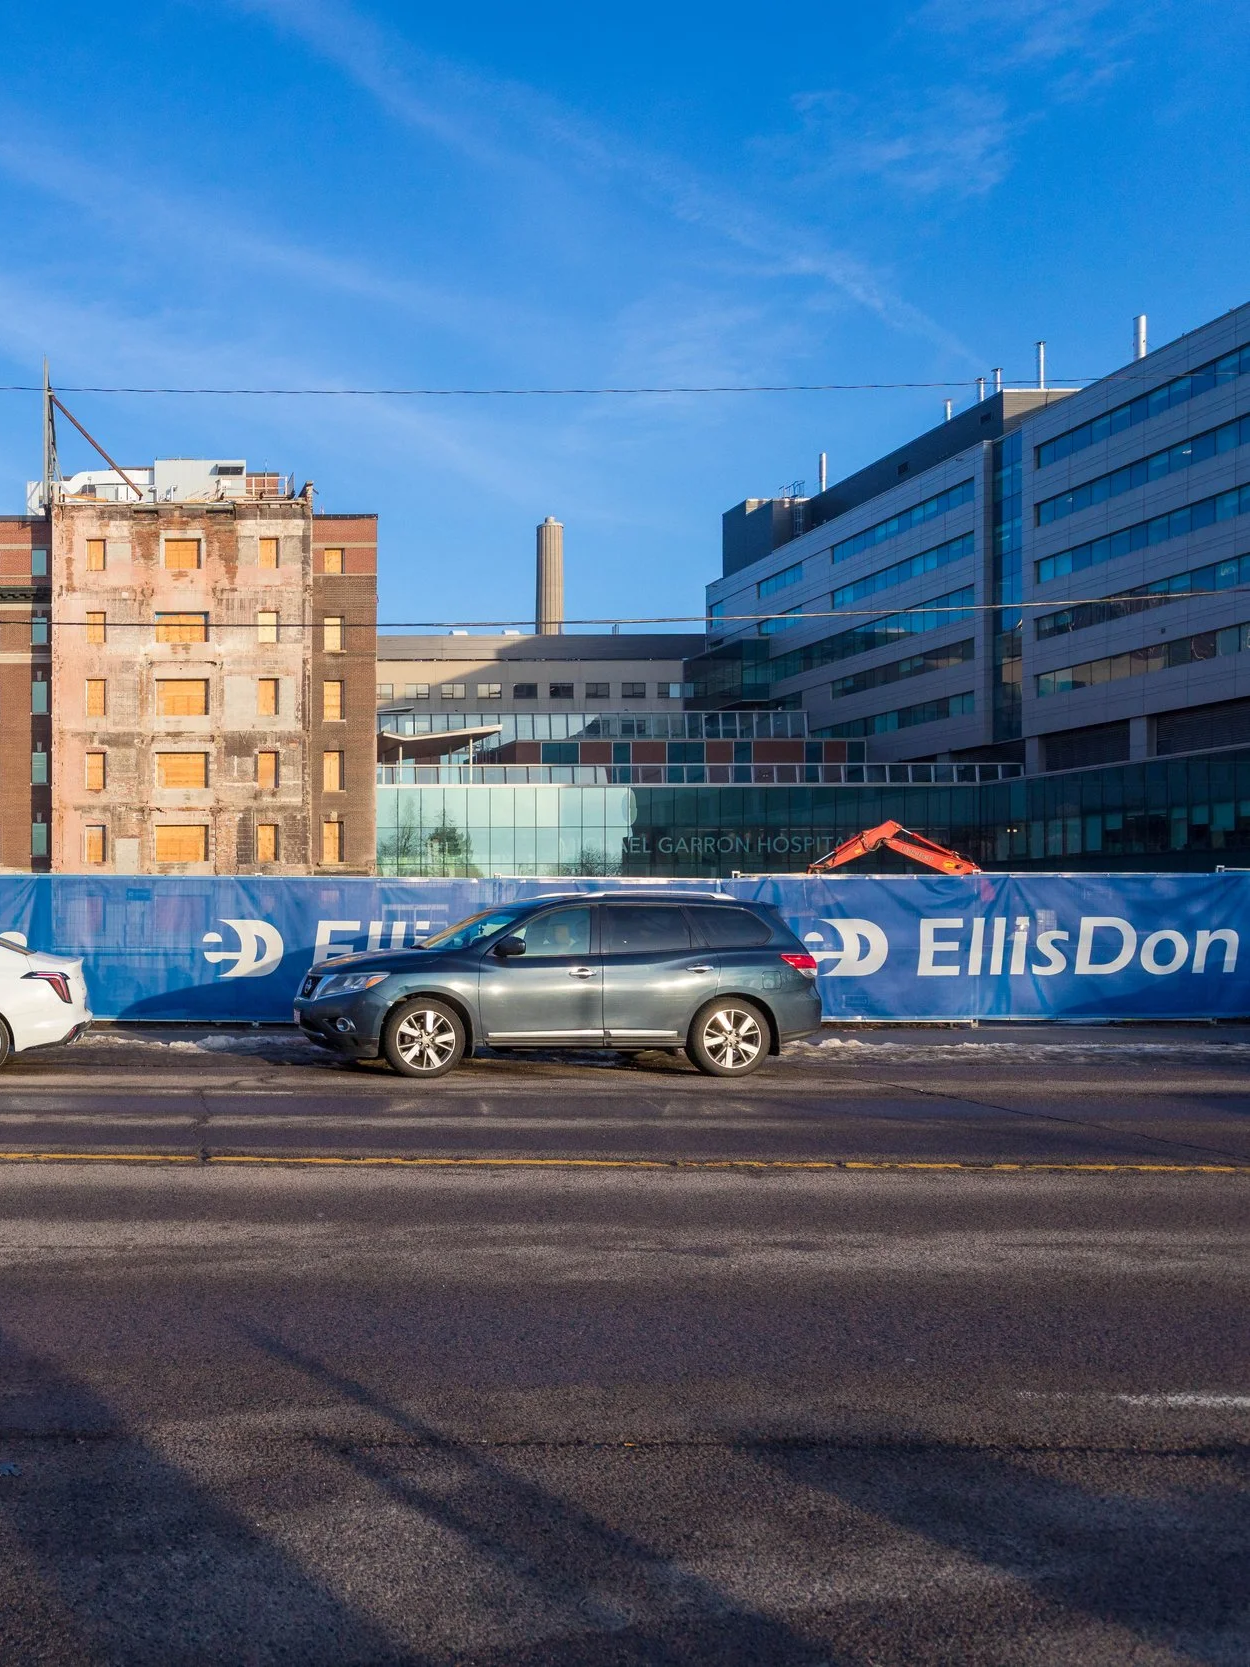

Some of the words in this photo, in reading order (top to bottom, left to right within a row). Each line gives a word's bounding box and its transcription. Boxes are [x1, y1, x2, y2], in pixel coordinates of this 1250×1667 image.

[658, 836, 750, 854] GARRON
[757, 836, 845, 853] HOSPITA
[917, 916, 1240, 976] EllisDon
